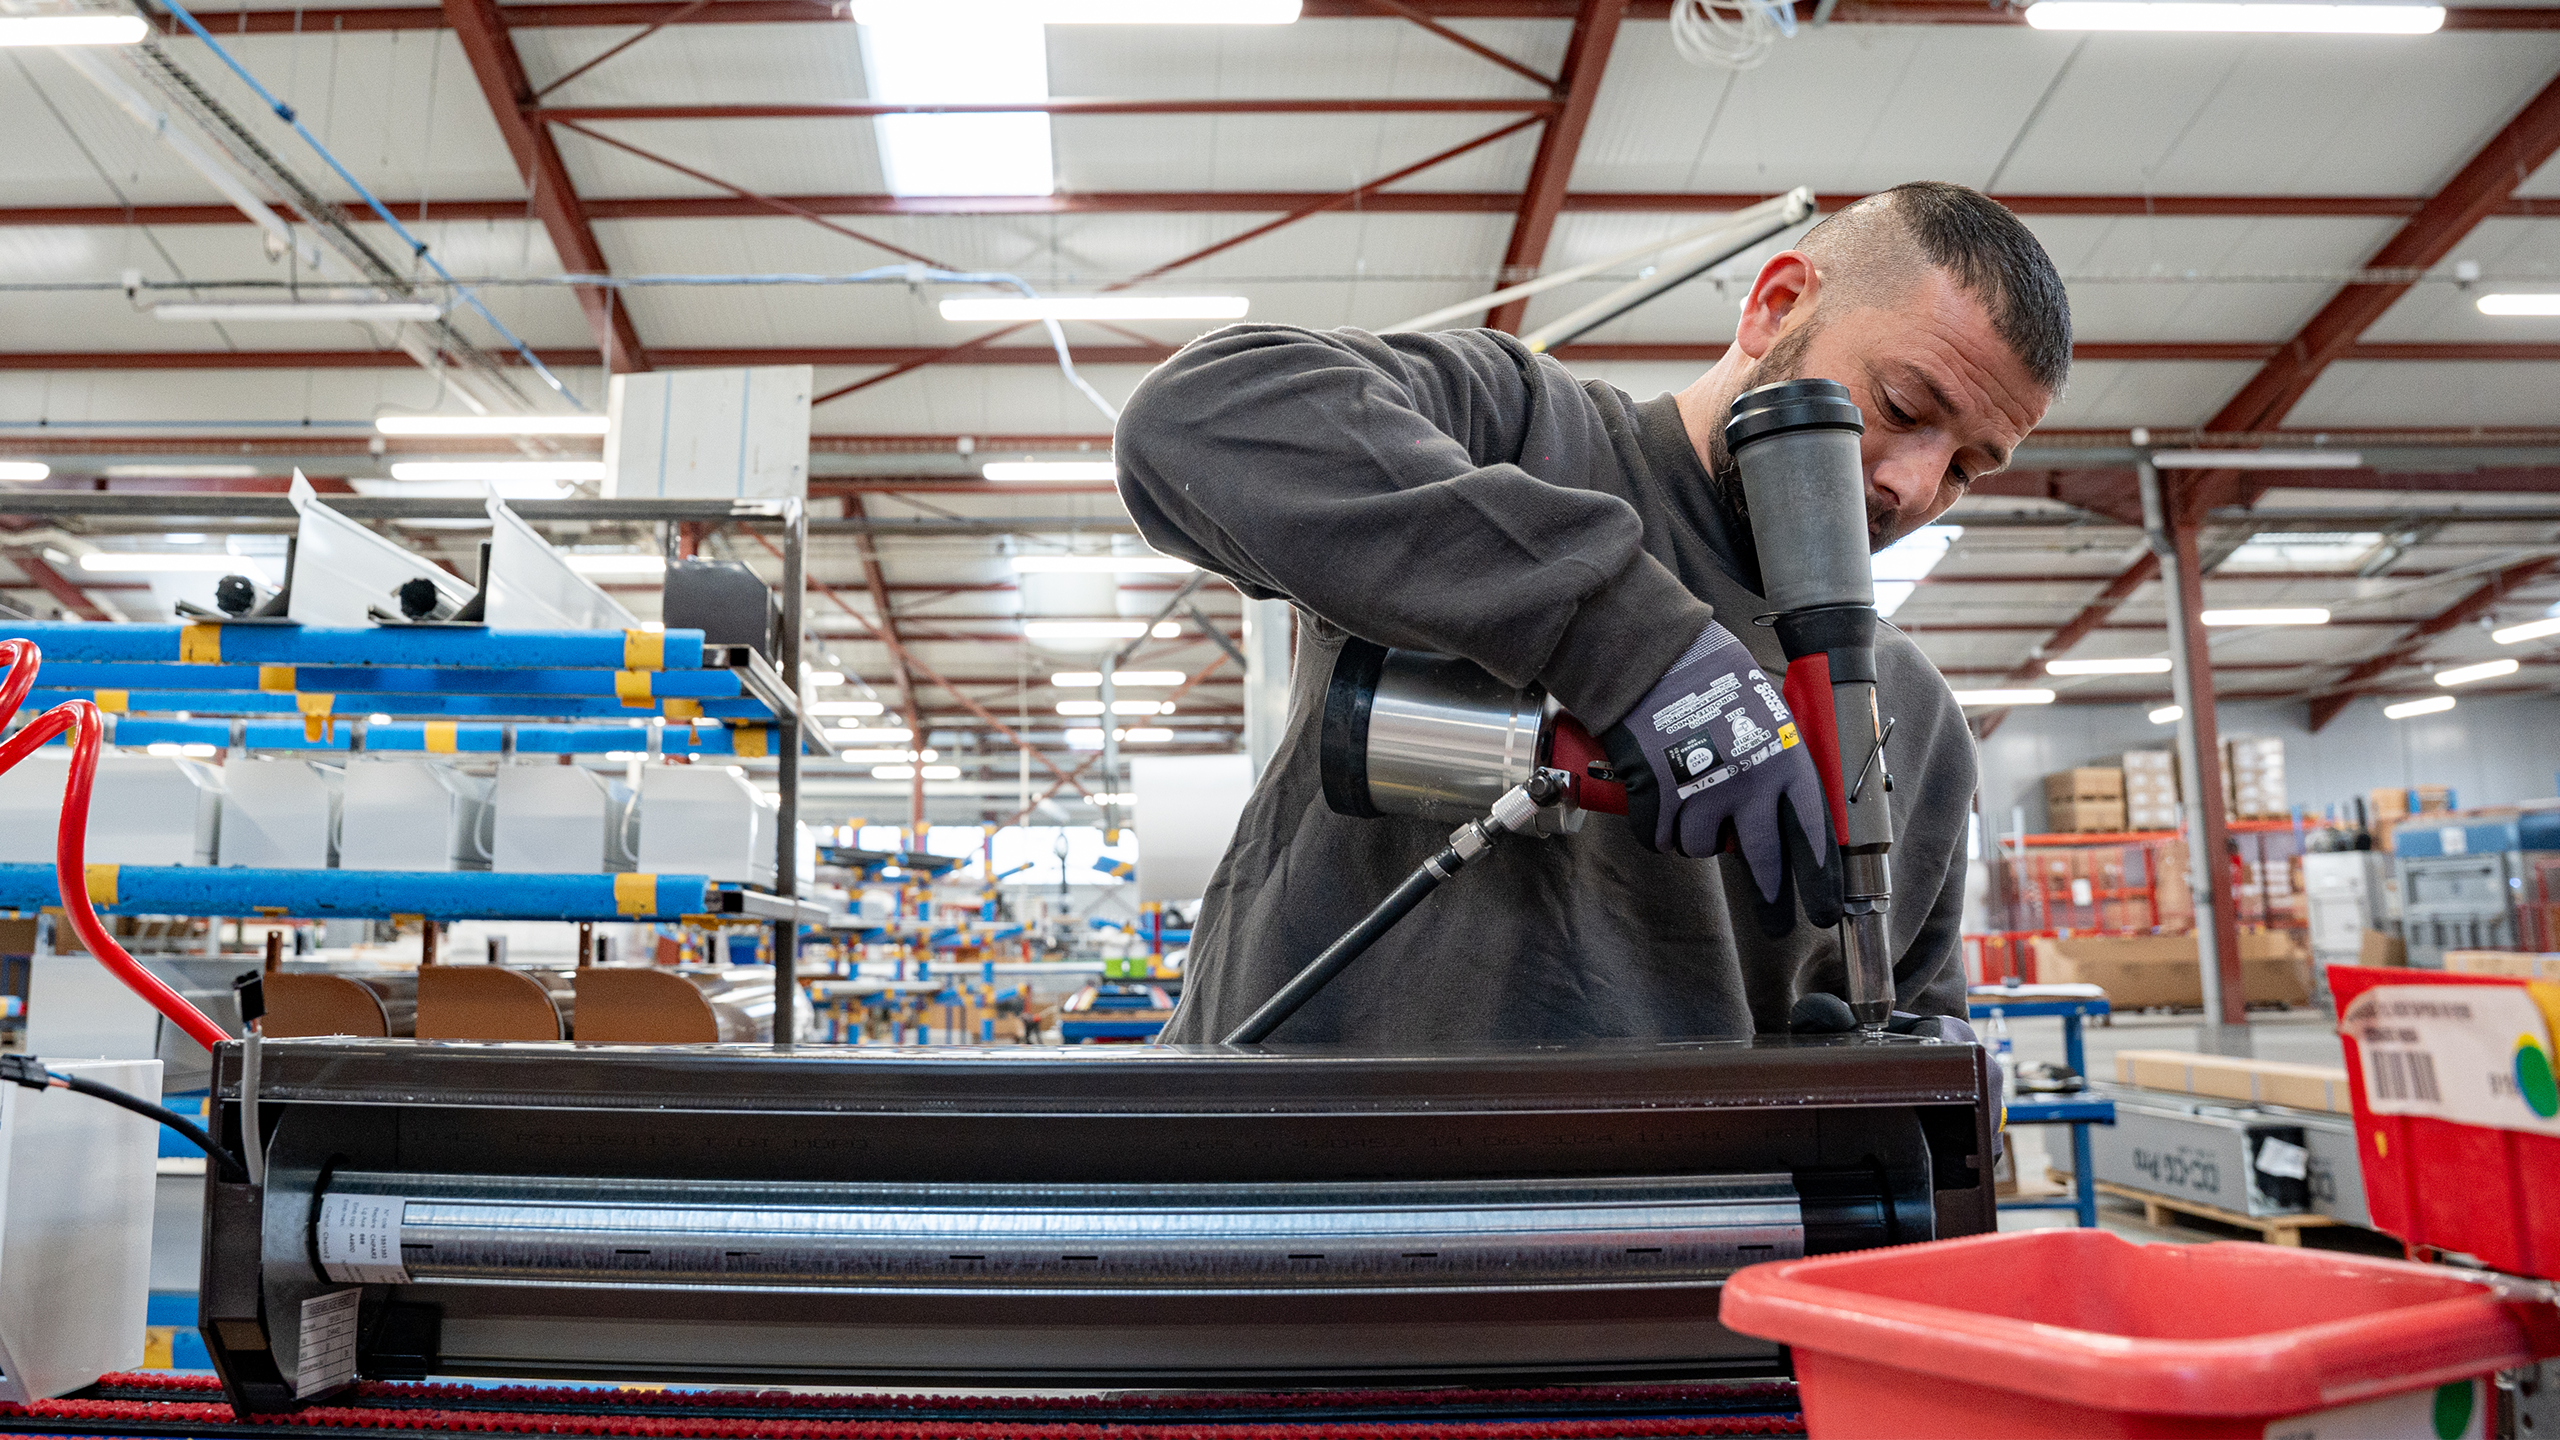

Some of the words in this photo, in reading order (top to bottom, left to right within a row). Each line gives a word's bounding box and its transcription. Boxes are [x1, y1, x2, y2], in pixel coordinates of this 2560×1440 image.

[1697, 692, 1738, 719] EUROLITE
[1666, 714, 1697, 734] 15N600
[1761, 730, 1771, 740] EN
[1679, 737, 1708, 754] STANDARD
[1691, 755, 1710, 768] OEKO
